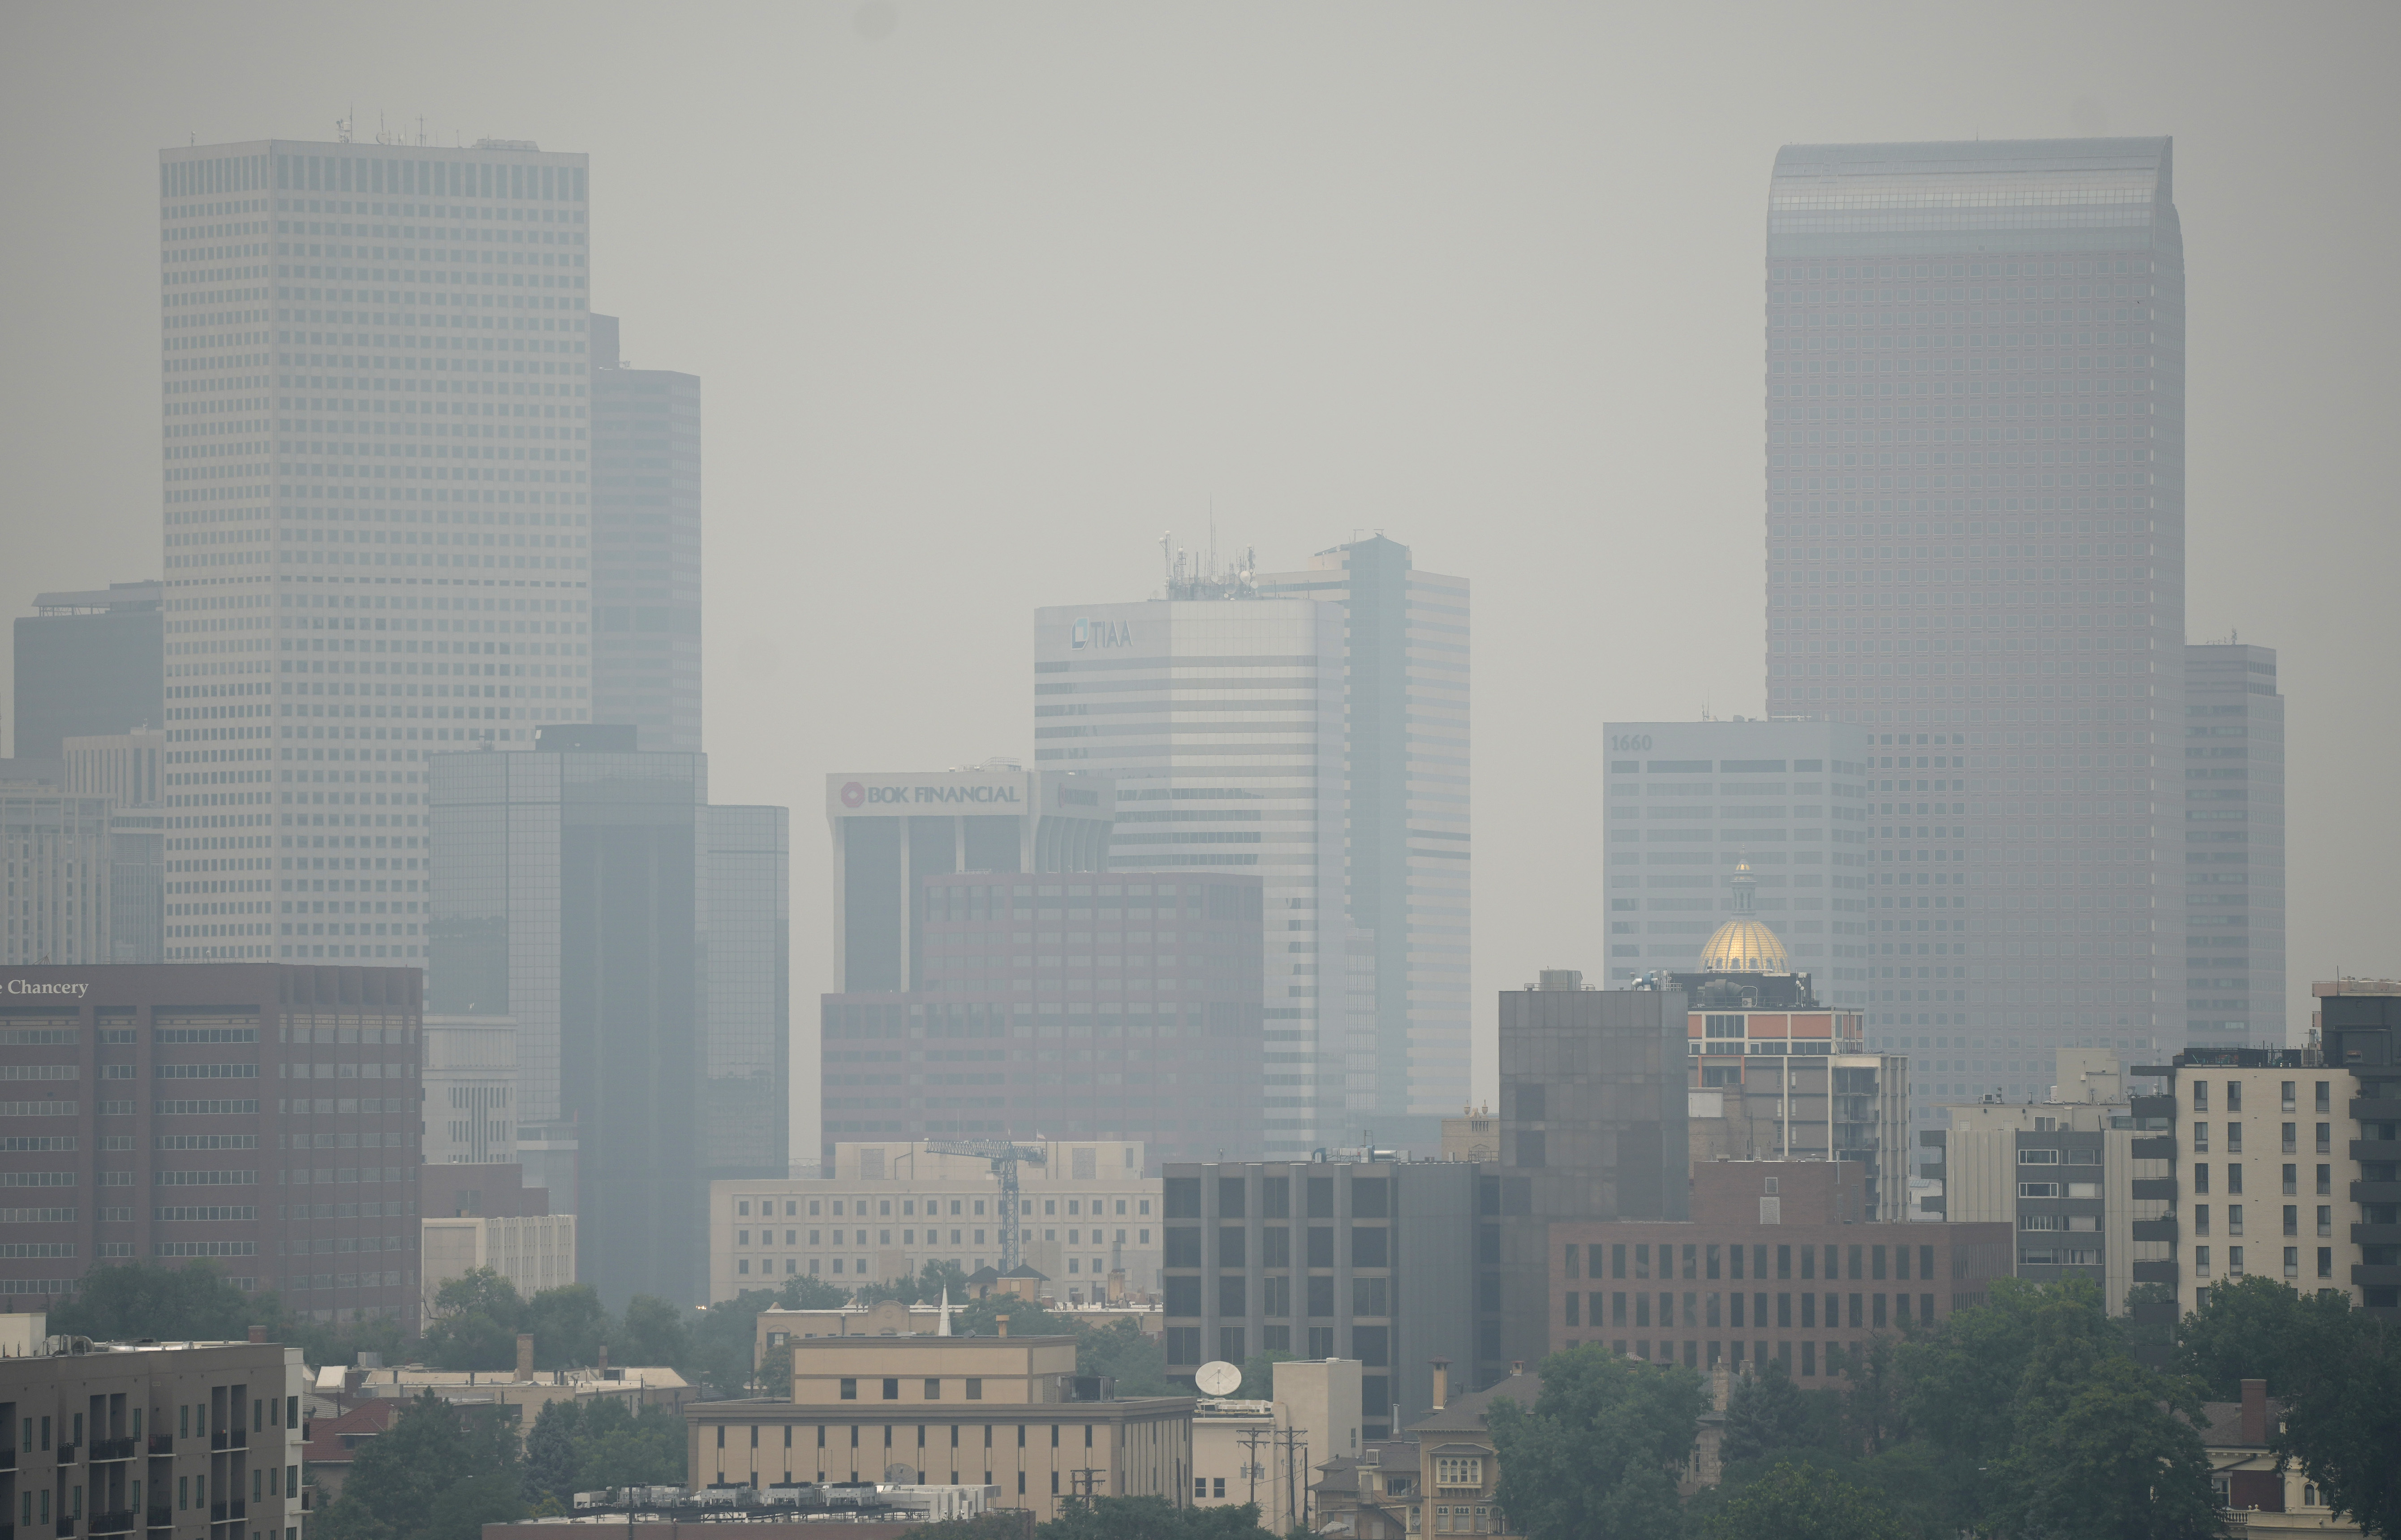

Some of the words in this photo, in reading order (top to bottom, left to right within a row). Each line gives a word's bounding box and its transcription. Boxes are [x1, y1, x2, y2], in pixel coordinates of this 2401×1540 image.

[1090, 620, 1133, 648] TIAA
[1611, 734, 1652, 751] 1660
[868, 787, 909, 803] BOK
[915, 786, 1020, 803] FINANCIAL
[8, 979, 89, 998] Chancery
